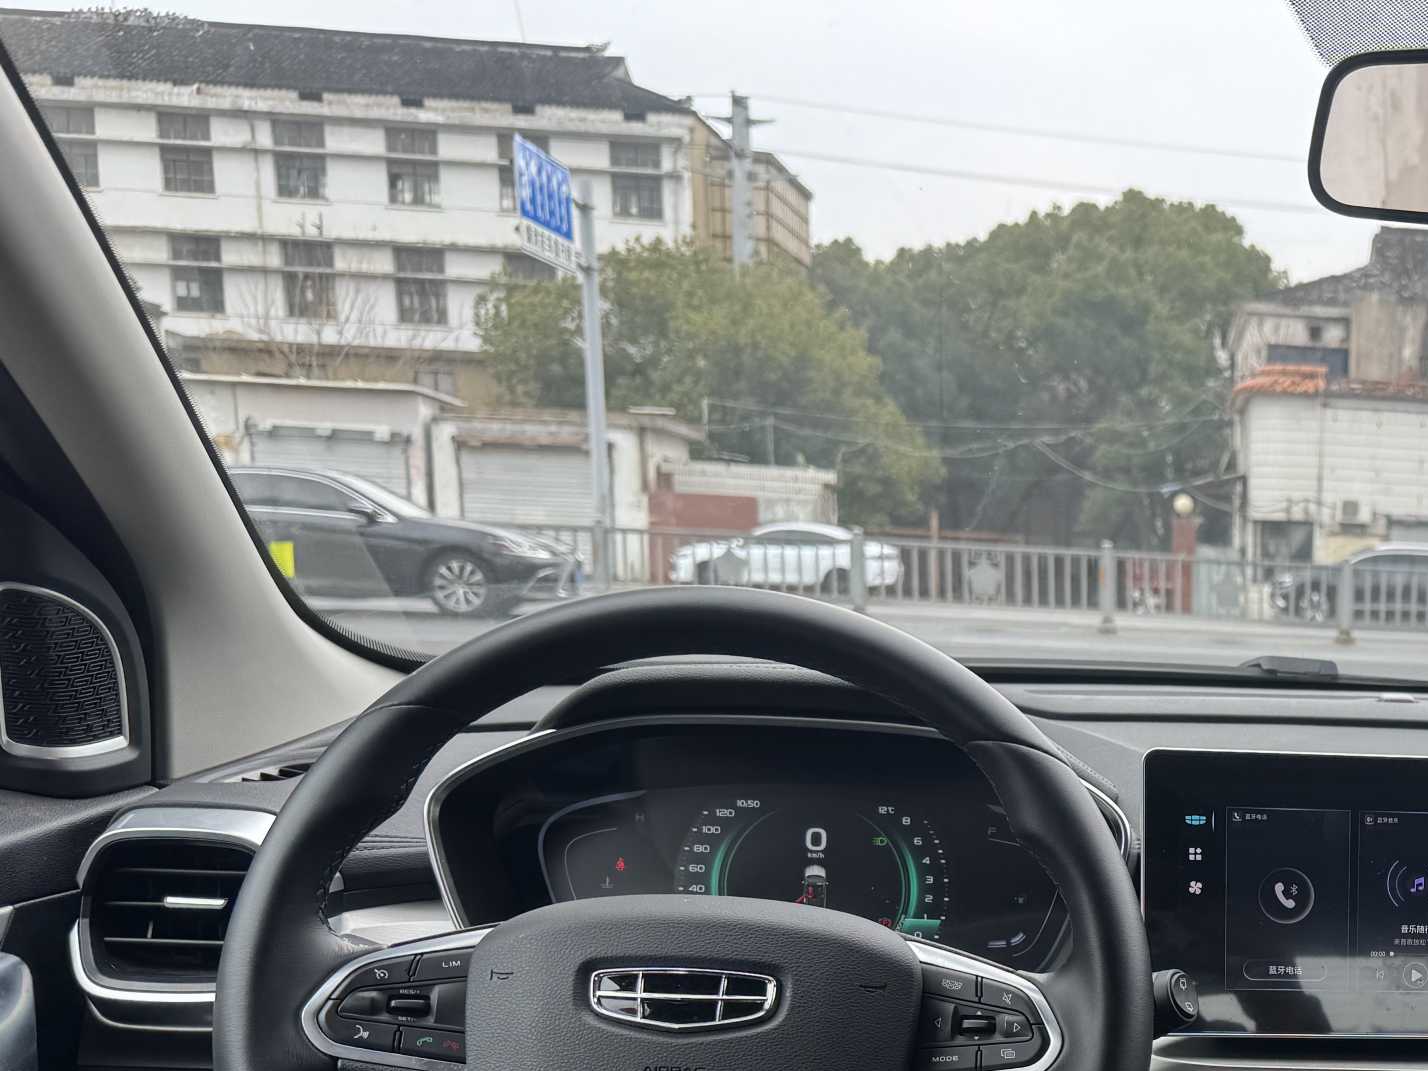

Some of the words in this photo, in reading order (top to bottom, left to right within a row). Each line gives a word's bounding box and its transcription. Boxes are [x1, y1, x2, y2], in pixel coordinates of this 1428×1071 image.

[716, 808, 735, 817] 120
[902, 816, 911, 825] 8
[805, 828, 827, 851] 0
[914, 837, 922, 845] 6
[693, 845, 710, 853] 80
[922, 856, 930, 864] 4
[689, 864, 705, 873] 60
[925, 876, 934, 884] 3
[688, 885, 705, 893] 40
[925, 895, 933, 903] 2
